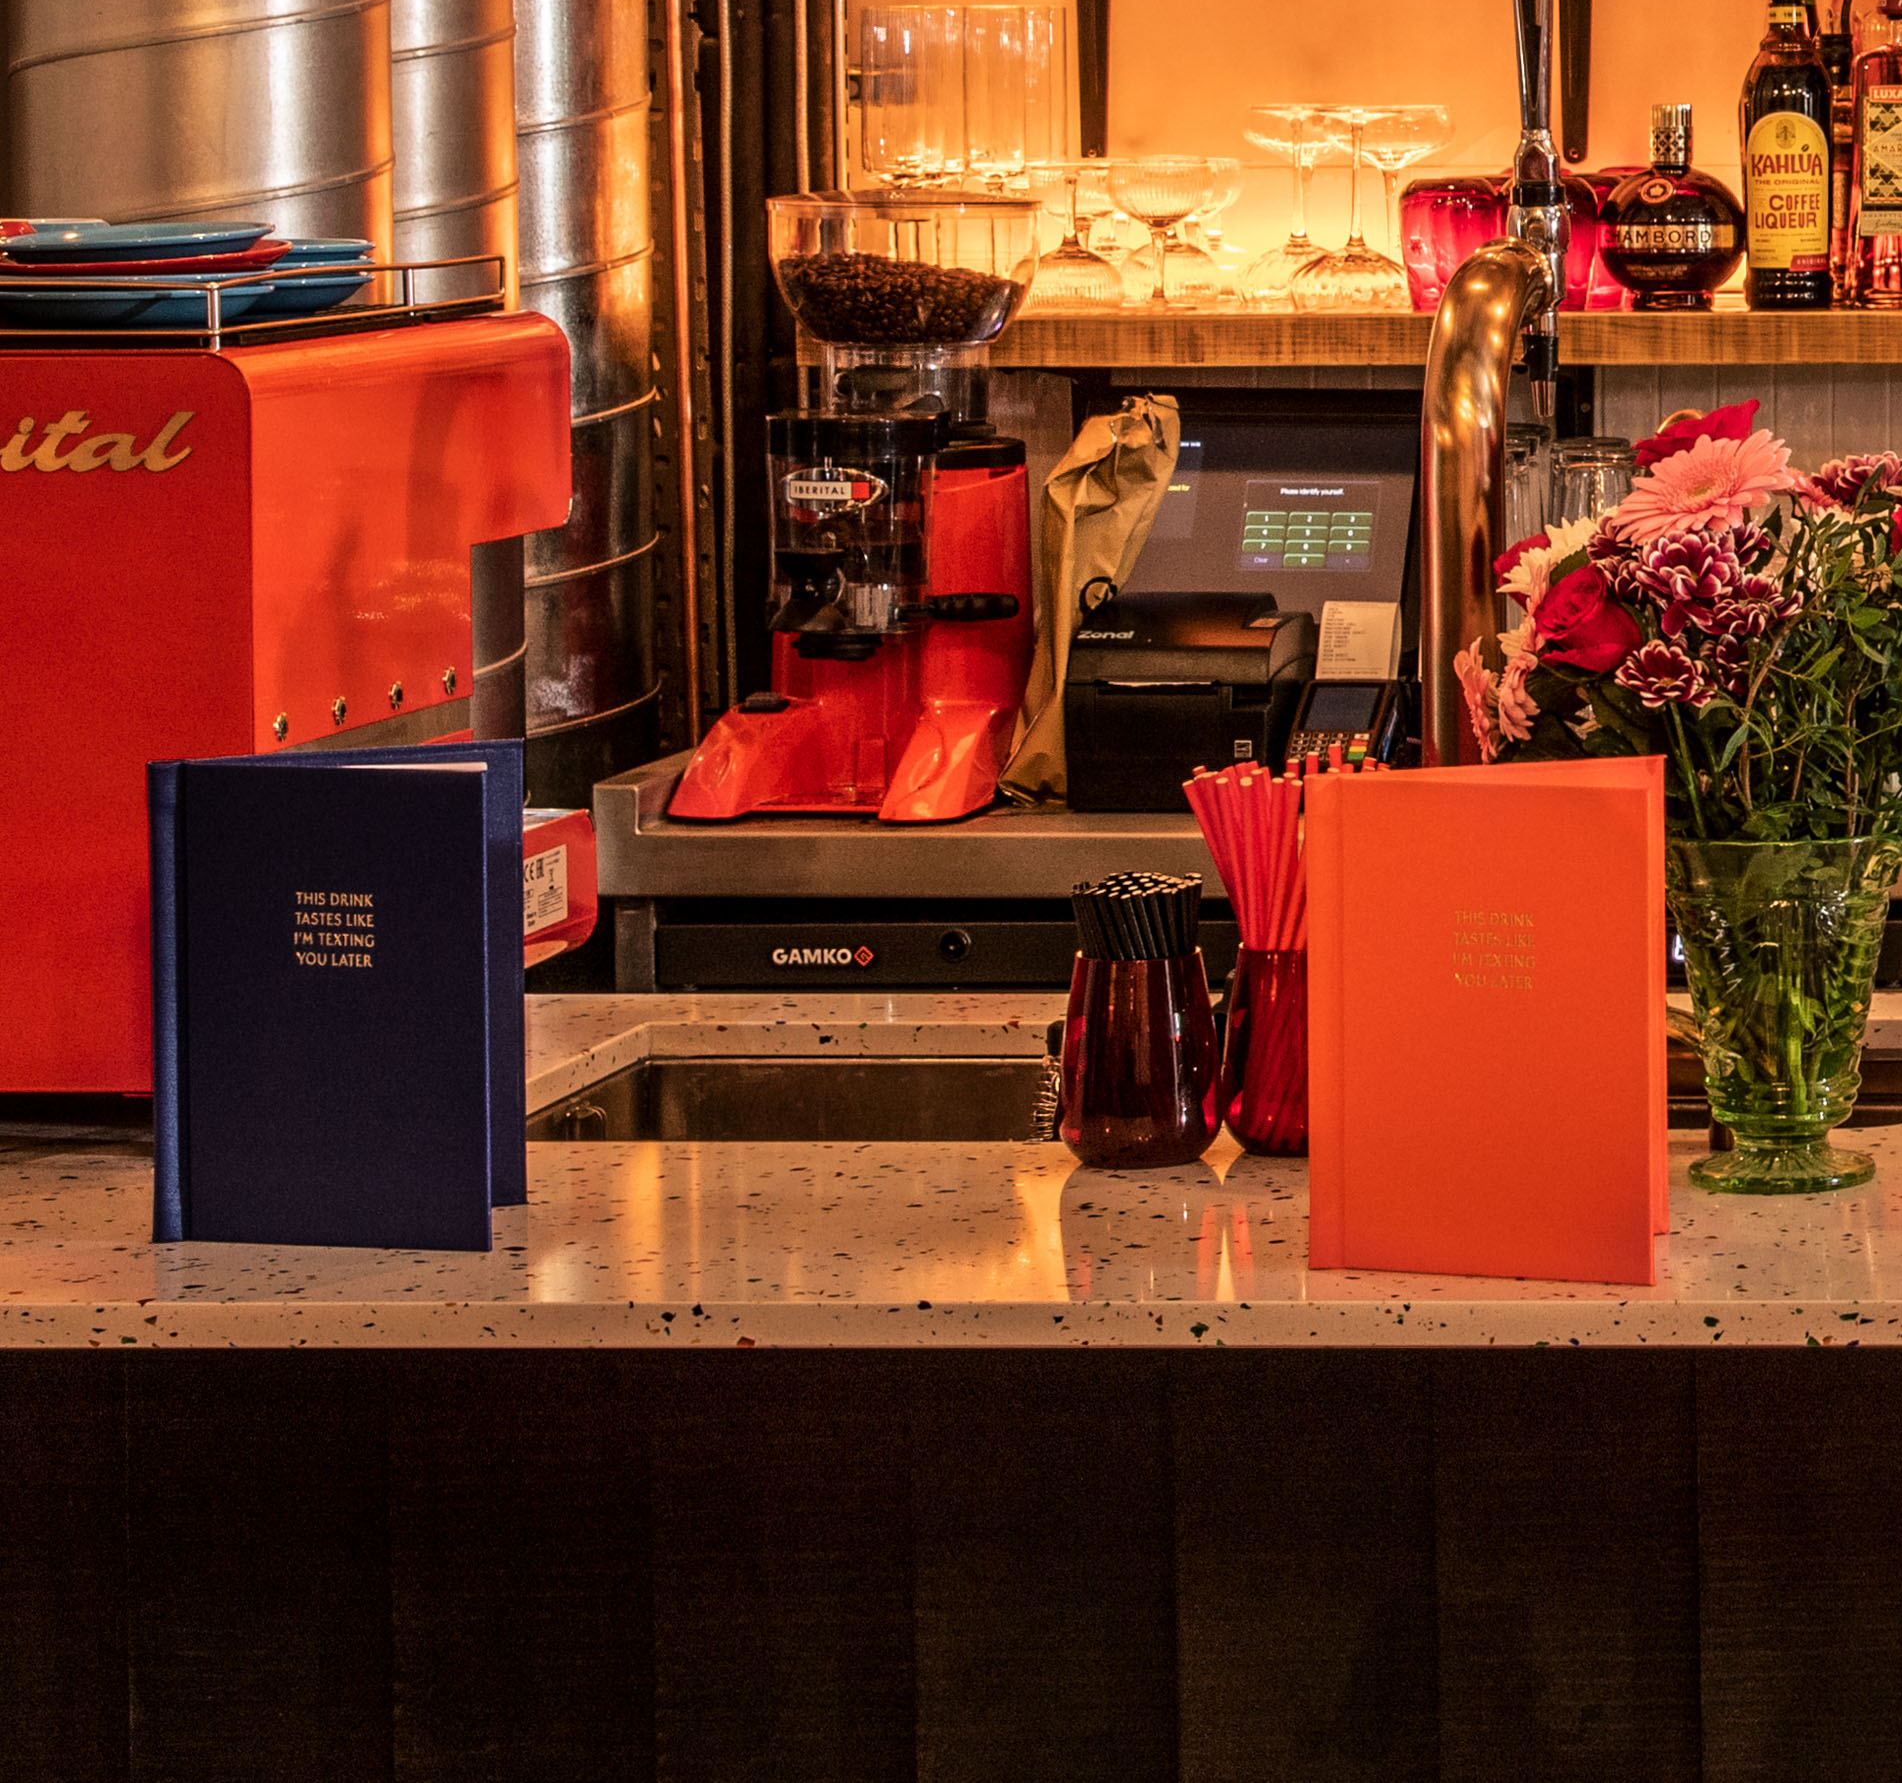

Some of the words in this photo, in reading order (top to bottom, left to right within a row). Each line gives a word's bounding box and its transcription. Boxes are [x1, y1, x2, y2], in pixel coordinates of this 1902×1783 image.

[1751, 143, 1823, 178] KAHLÚA
[1768, 193, 1821, 212] COFFEE
[1754, 211, 1818, 230] LIQUEUR
[794, 483, 846, 497] IBERITAL
[1077, 629, 1136, 641] Zonal
[296, 891, 327, 906] THIS
[330, 893, 375, 908] DRINK
[295, 911, 343, 927] TASTES
[346, 914, 376, 928] LIKE
[1455, 910, 1485, 926] THIS
[1488, 911, 1535, 928] DRINK
[294, 931, 315, 946] I'M
[318, 933, 376, 949] TEXTING
[1452, 931, 1500, 948] TASTES
[1504, 931, 1536, 948] LIKE
[296, 951, 329, 967] YOU
[331, 953, 374, 968] LATER
[772, 946, 852, 967] GAMKO
[1454, 972, 1486, 988] YOU
